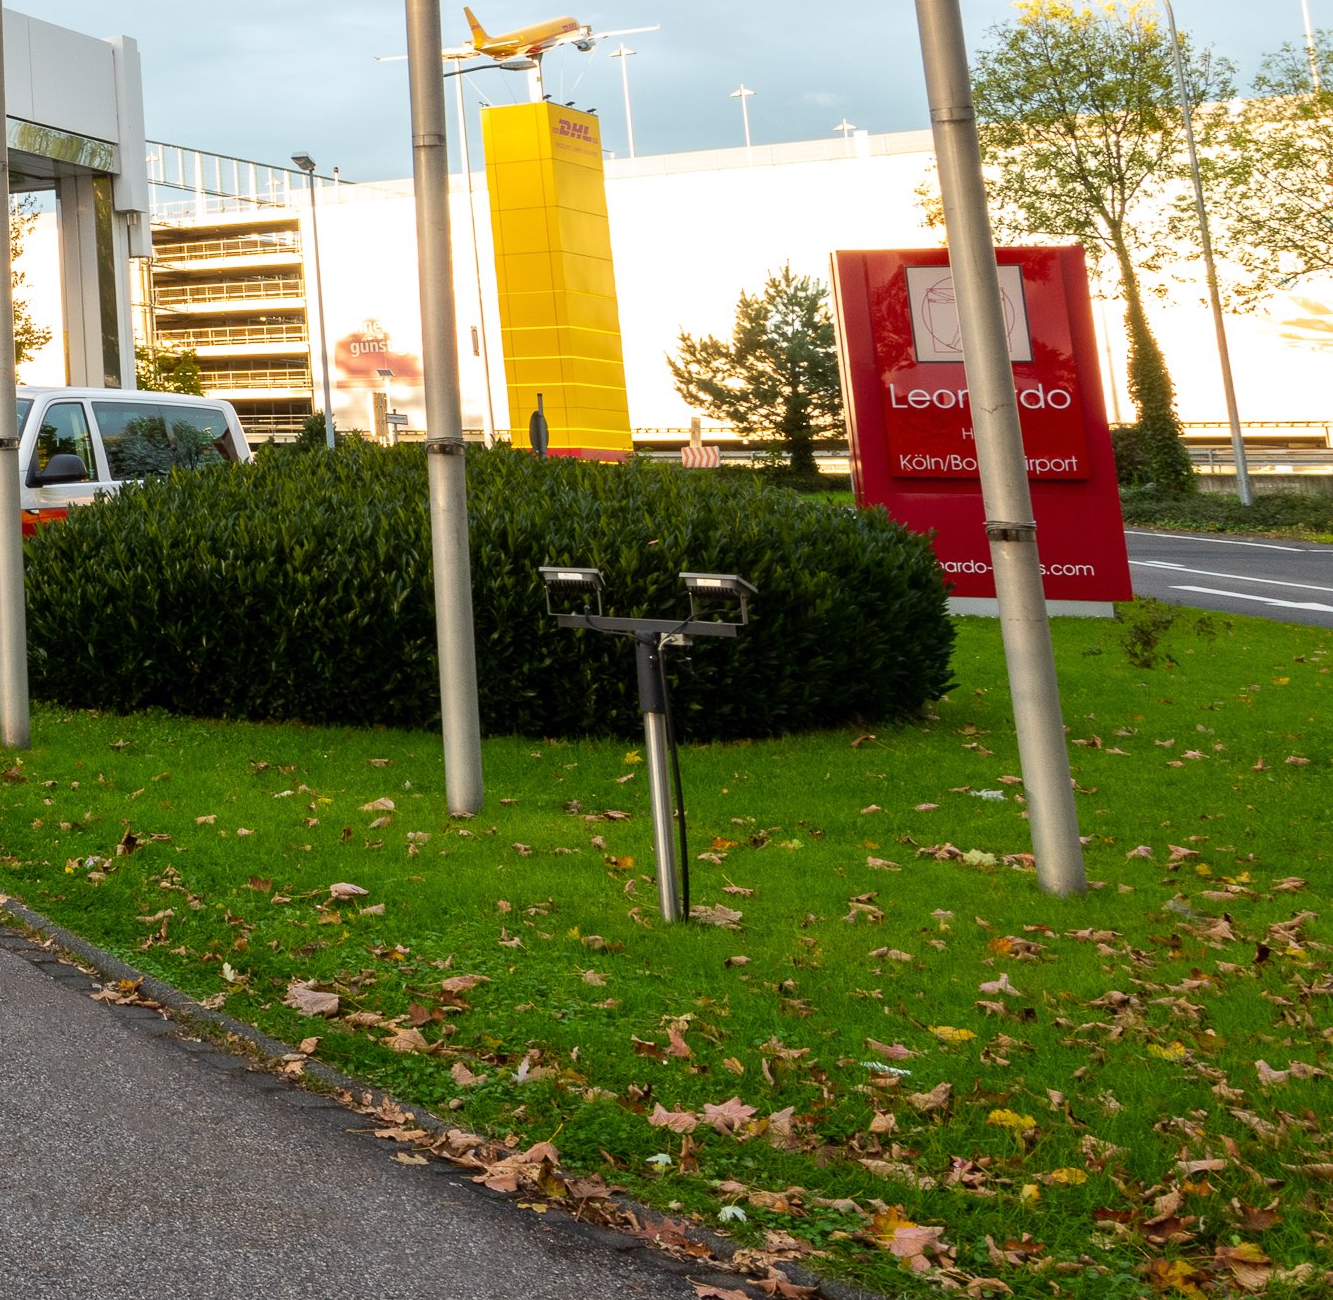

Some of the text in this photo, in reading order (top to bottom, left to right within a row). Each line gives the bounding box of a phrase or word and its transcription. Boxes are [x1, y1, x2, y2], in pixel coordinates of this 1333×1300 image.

[558, 118, 593, 143] DHL
[889, 383, 1071, 409] Leondo
[899, 454, 1078, 474] Köln/Bo irport
